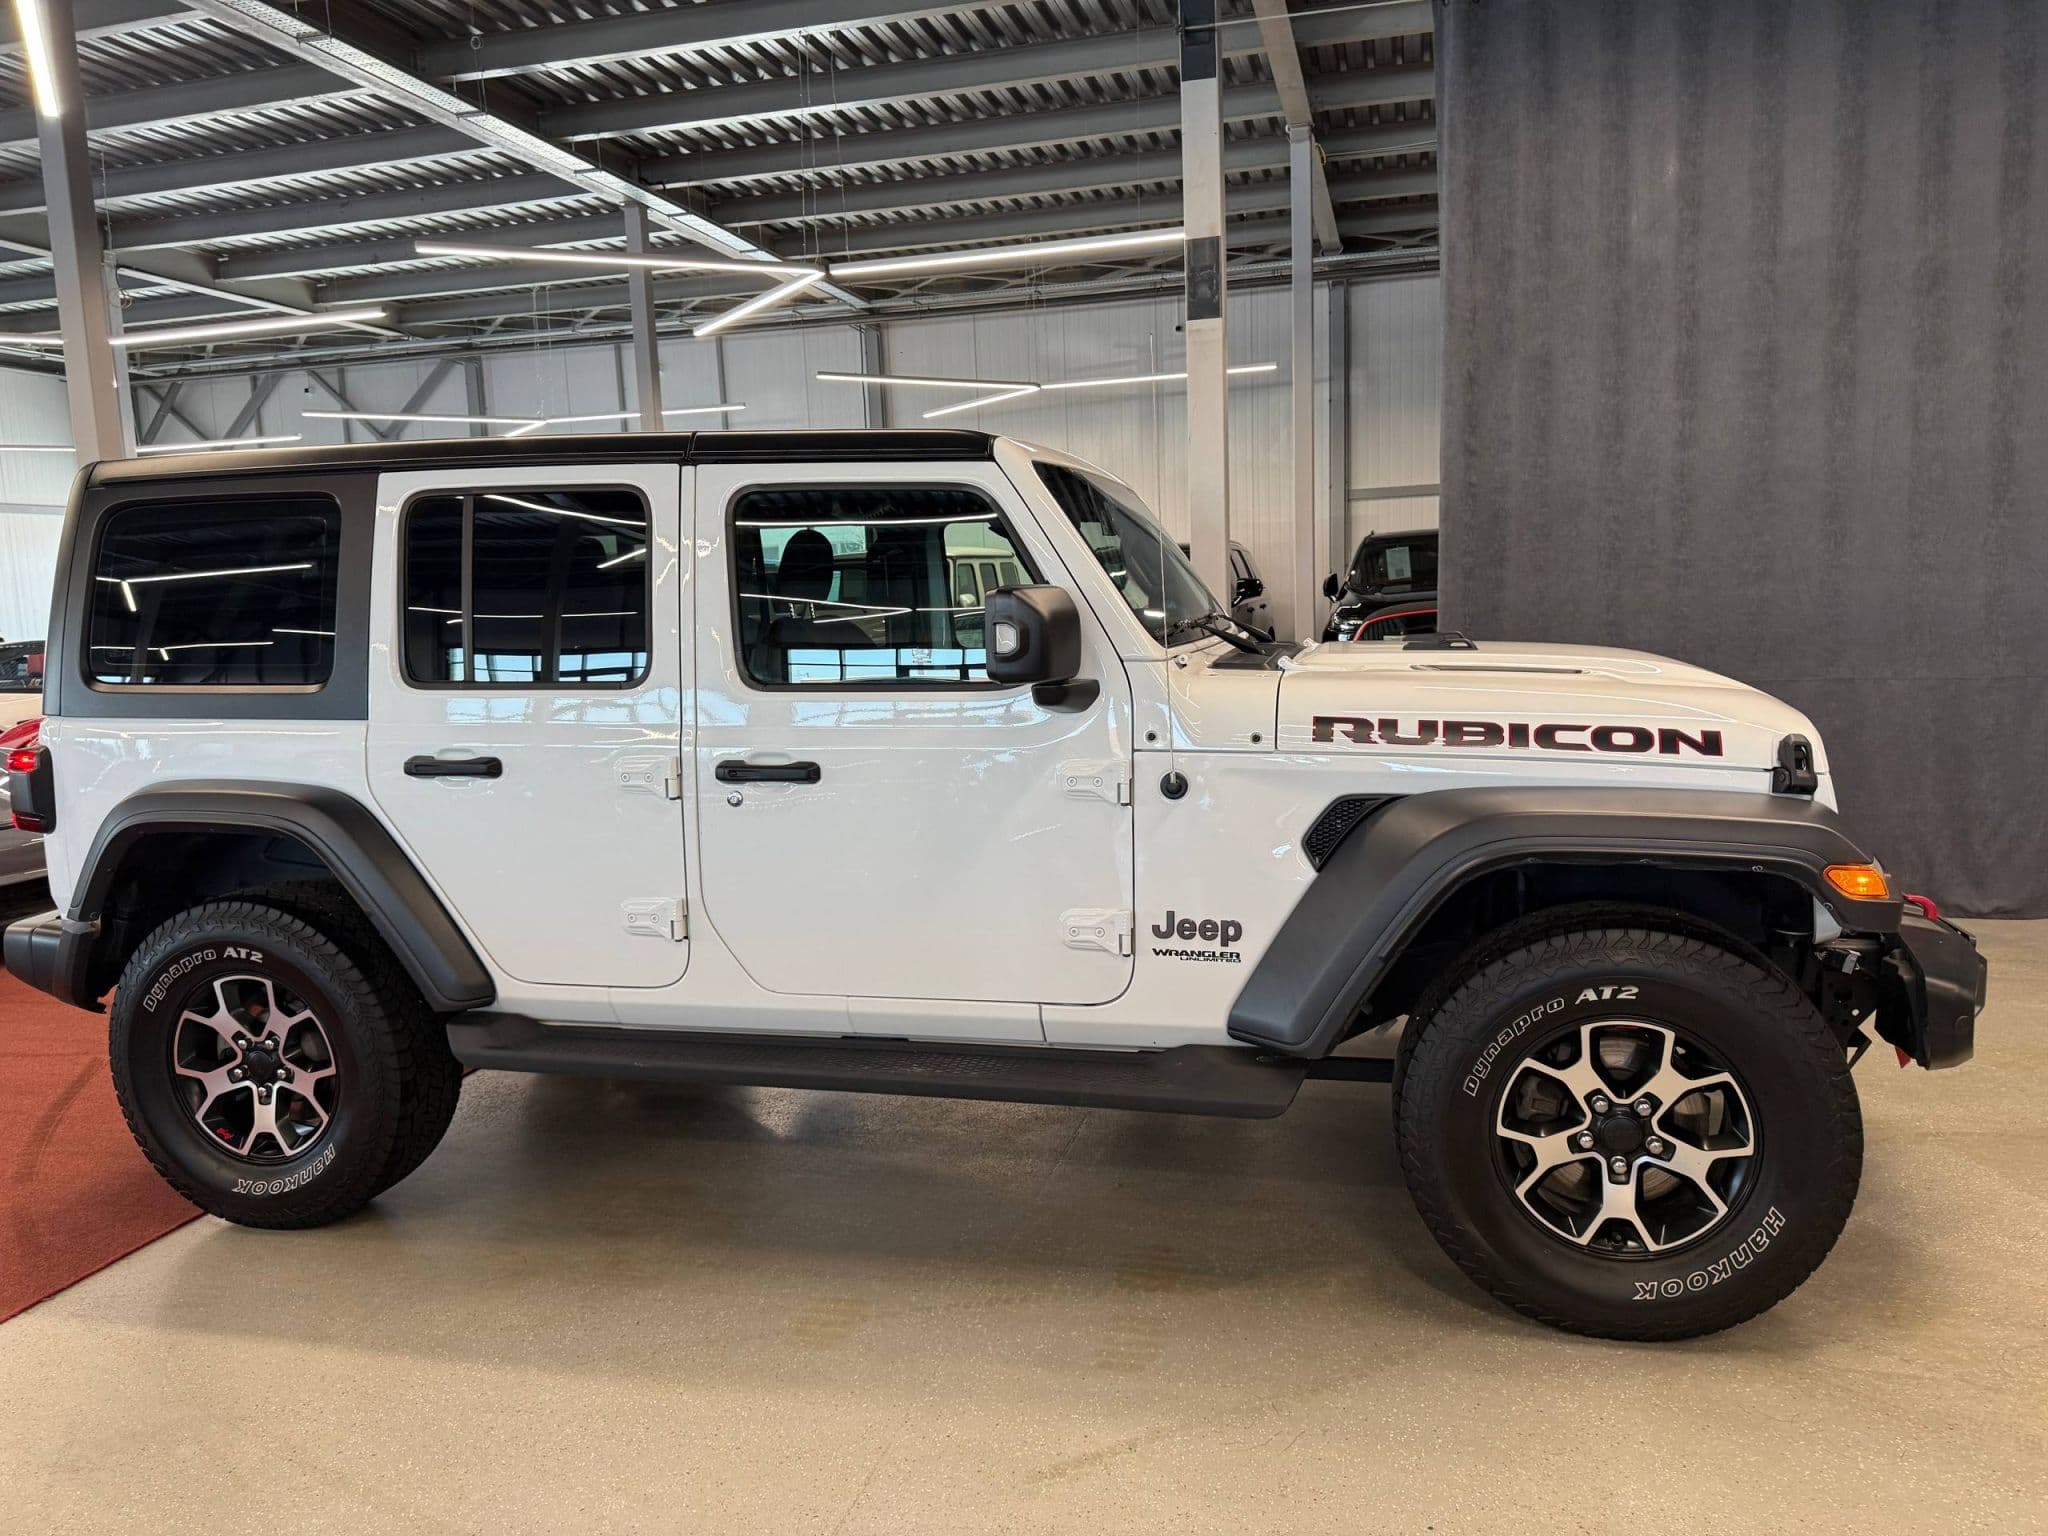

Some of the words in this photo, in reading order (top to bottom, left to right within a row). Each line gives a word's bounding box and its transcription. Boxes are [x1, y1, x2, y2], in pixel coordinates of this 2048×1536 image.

[1312, 715, 1723, 757] RUBICON
[1152, 910, 1242, 947] Jeep
[1152, 948, 1240, 960] WRANGLER
[143, 949, 216, 1013] Dynapro
[223, 946, 264, 963] AT2
[1463, 998, 1565, 1097] Dynapro
[1574, 985, 1640, 1005] AT2
[1632, 1205, 1786, 1301] Hankook
